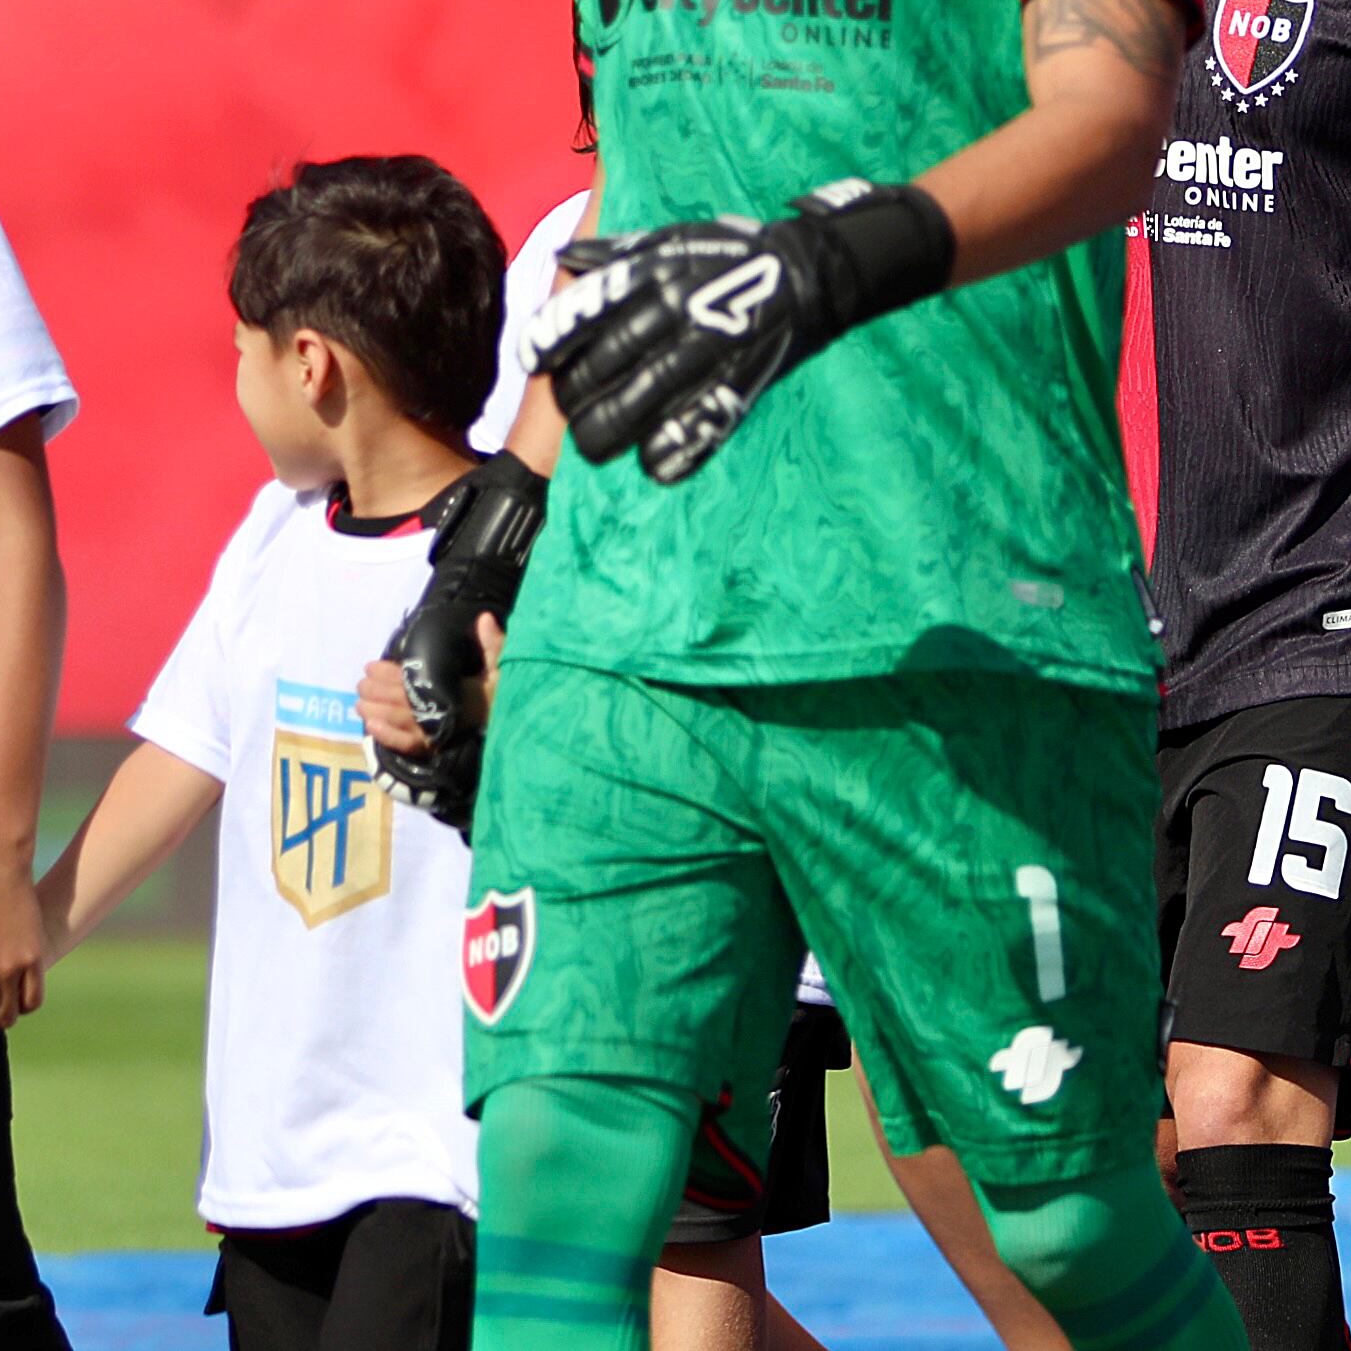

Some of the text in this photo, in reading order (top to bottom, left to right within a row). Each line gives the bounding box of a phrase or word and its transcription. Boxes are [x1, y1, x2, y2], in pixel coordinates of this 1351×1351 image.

[780, 22, 892, 49] ONLINE
[1228, 9, 1292, 44] NOB
[1184, 186, 1275, 213] ONLINE
[1164, 214, 1223, 231] Lotería de
[1163, 228, 1232, 248] Santa Fe
[304, 694, 343, 722] AFA
[468, 924, 521, 968] NOB
[1014, 863, 1066, 1003] 1
